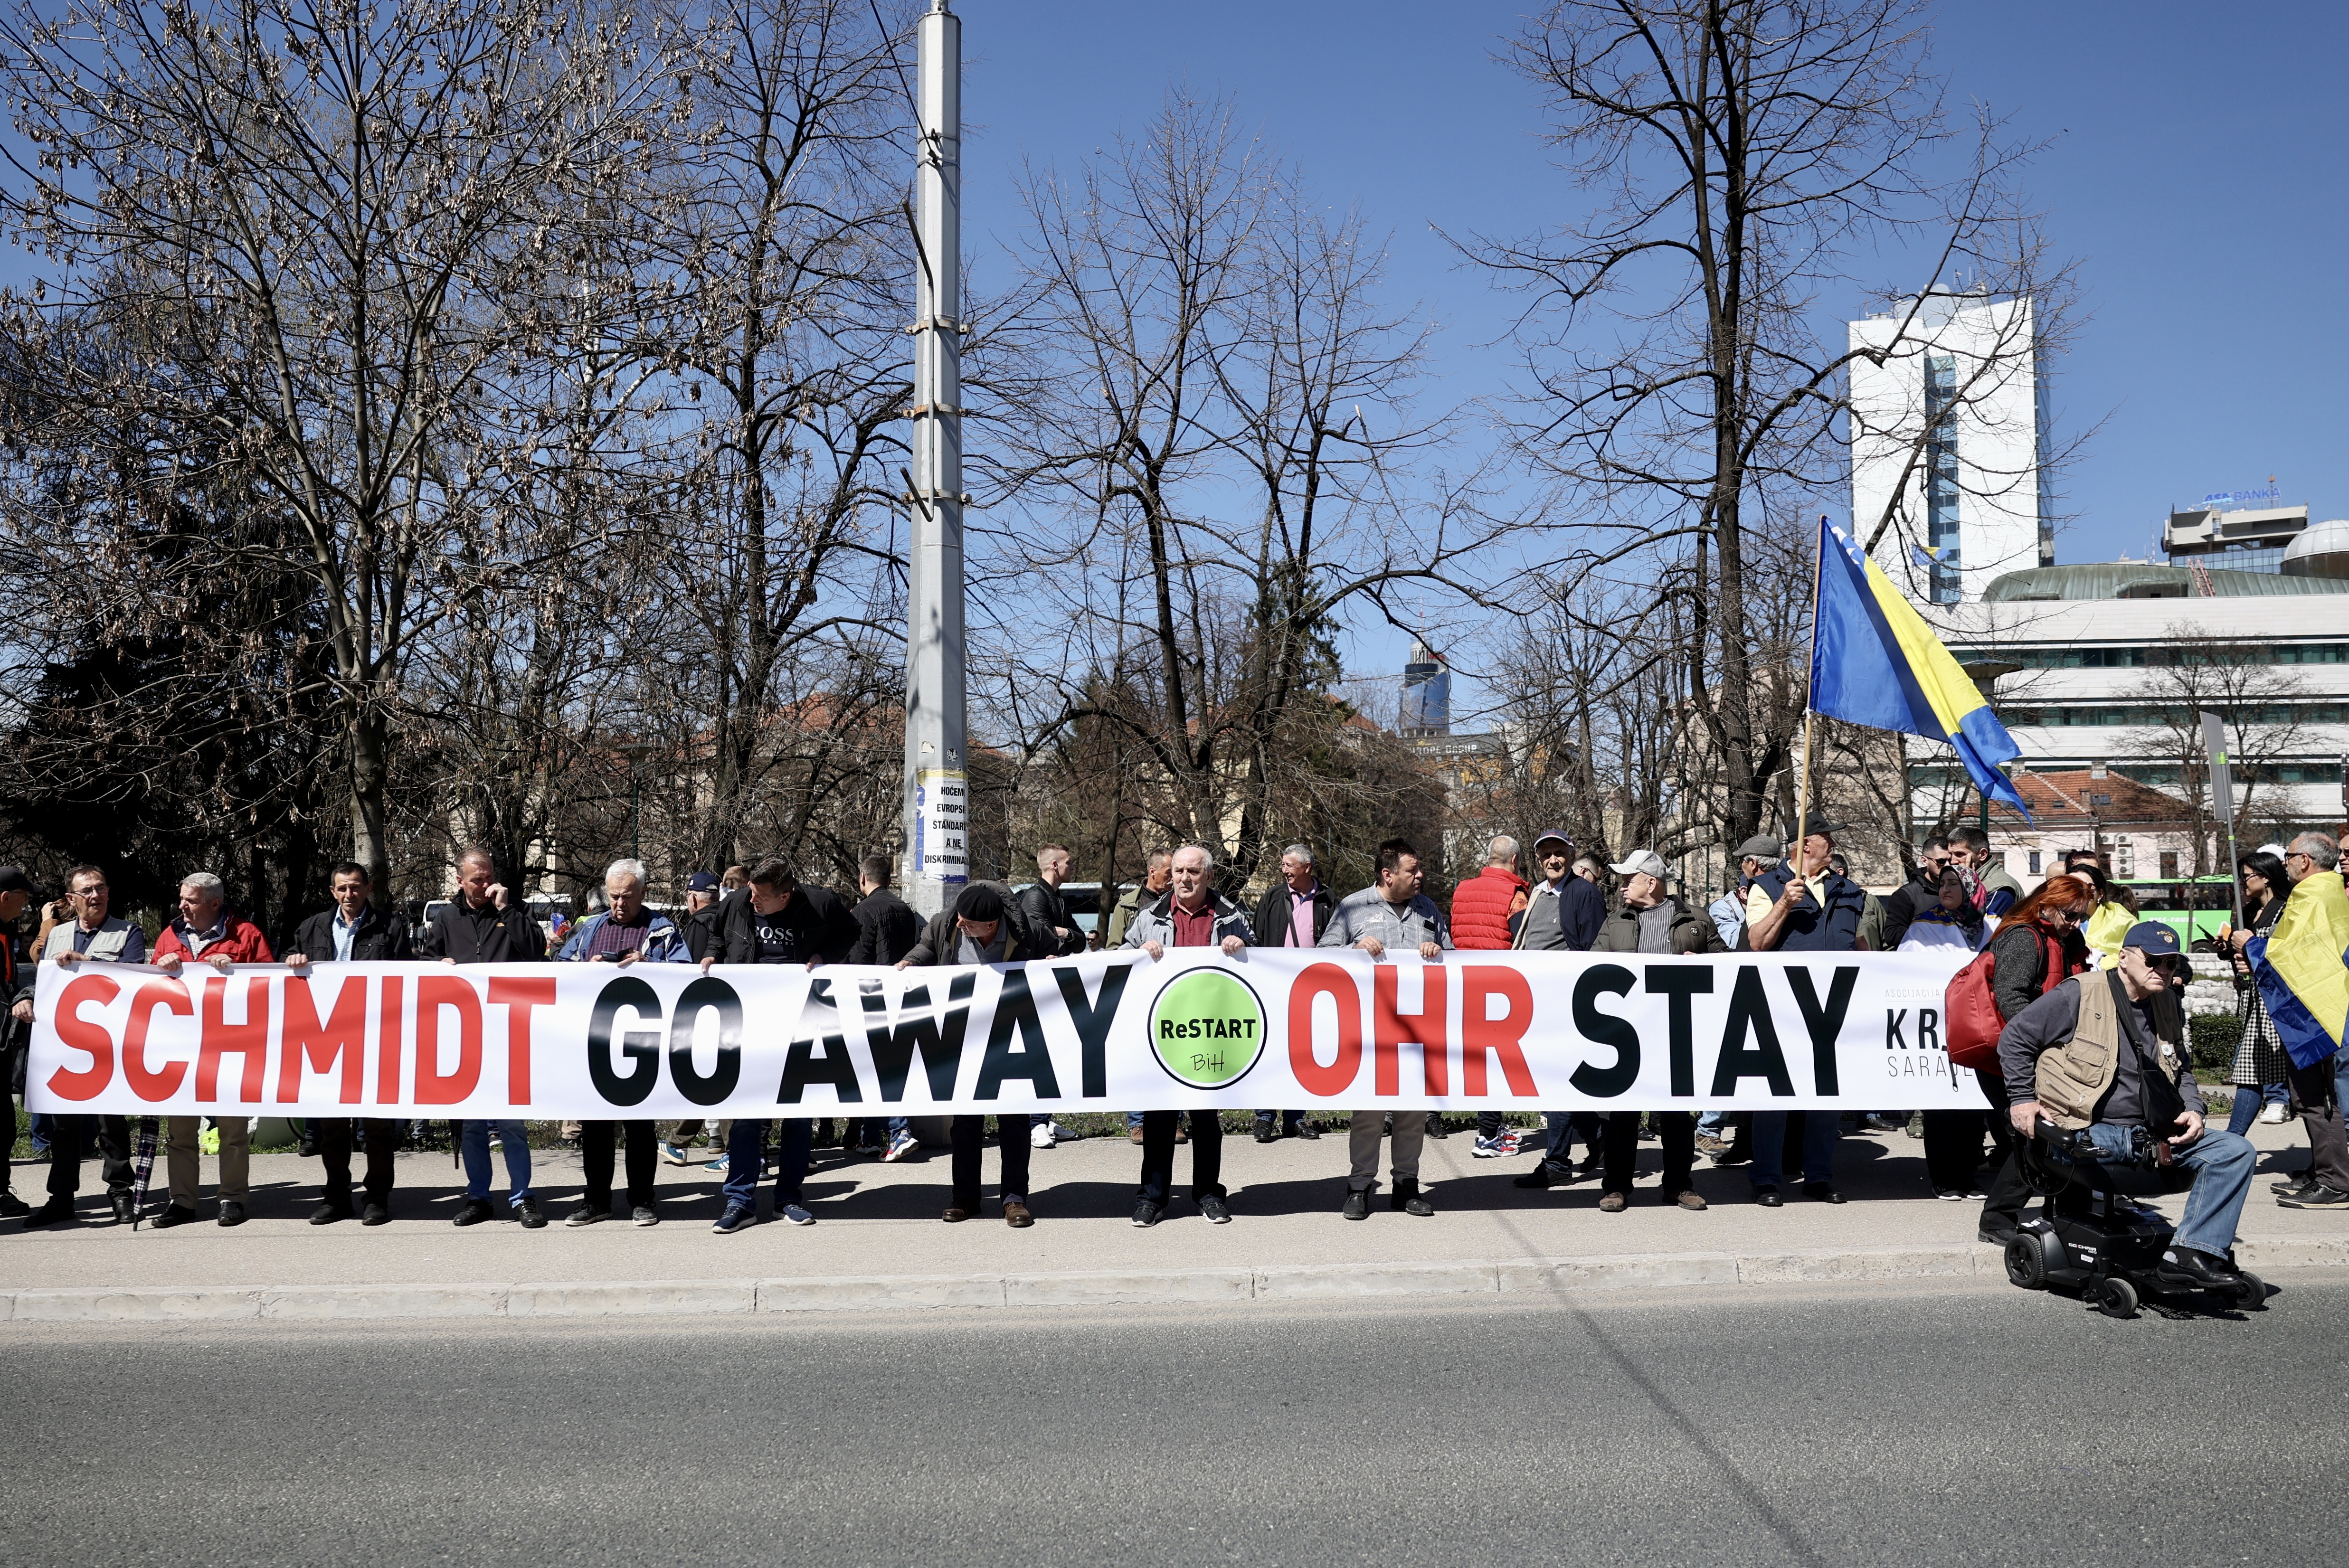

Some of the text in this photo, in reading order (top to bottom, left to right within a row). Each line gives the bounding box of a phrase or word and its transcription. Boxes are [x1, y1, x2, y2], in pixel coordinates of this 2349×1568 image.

[2234, 487, 2281, 501] BANKA
[946, 839, 961, 848] A NE
[925, 855, 968, 865] DISKRIMINA
[1885, 989, 1941, 998] ASOCIJACIJA
[47, 962, 1860, 1107] SCHMIDT GO AWAY OHR STAY
[1161, 1019, 1256, 1039] ReSTART
[1886, 1008, 1939, 1049] KR
[1190, 1050, 1224, 1073] BiH
